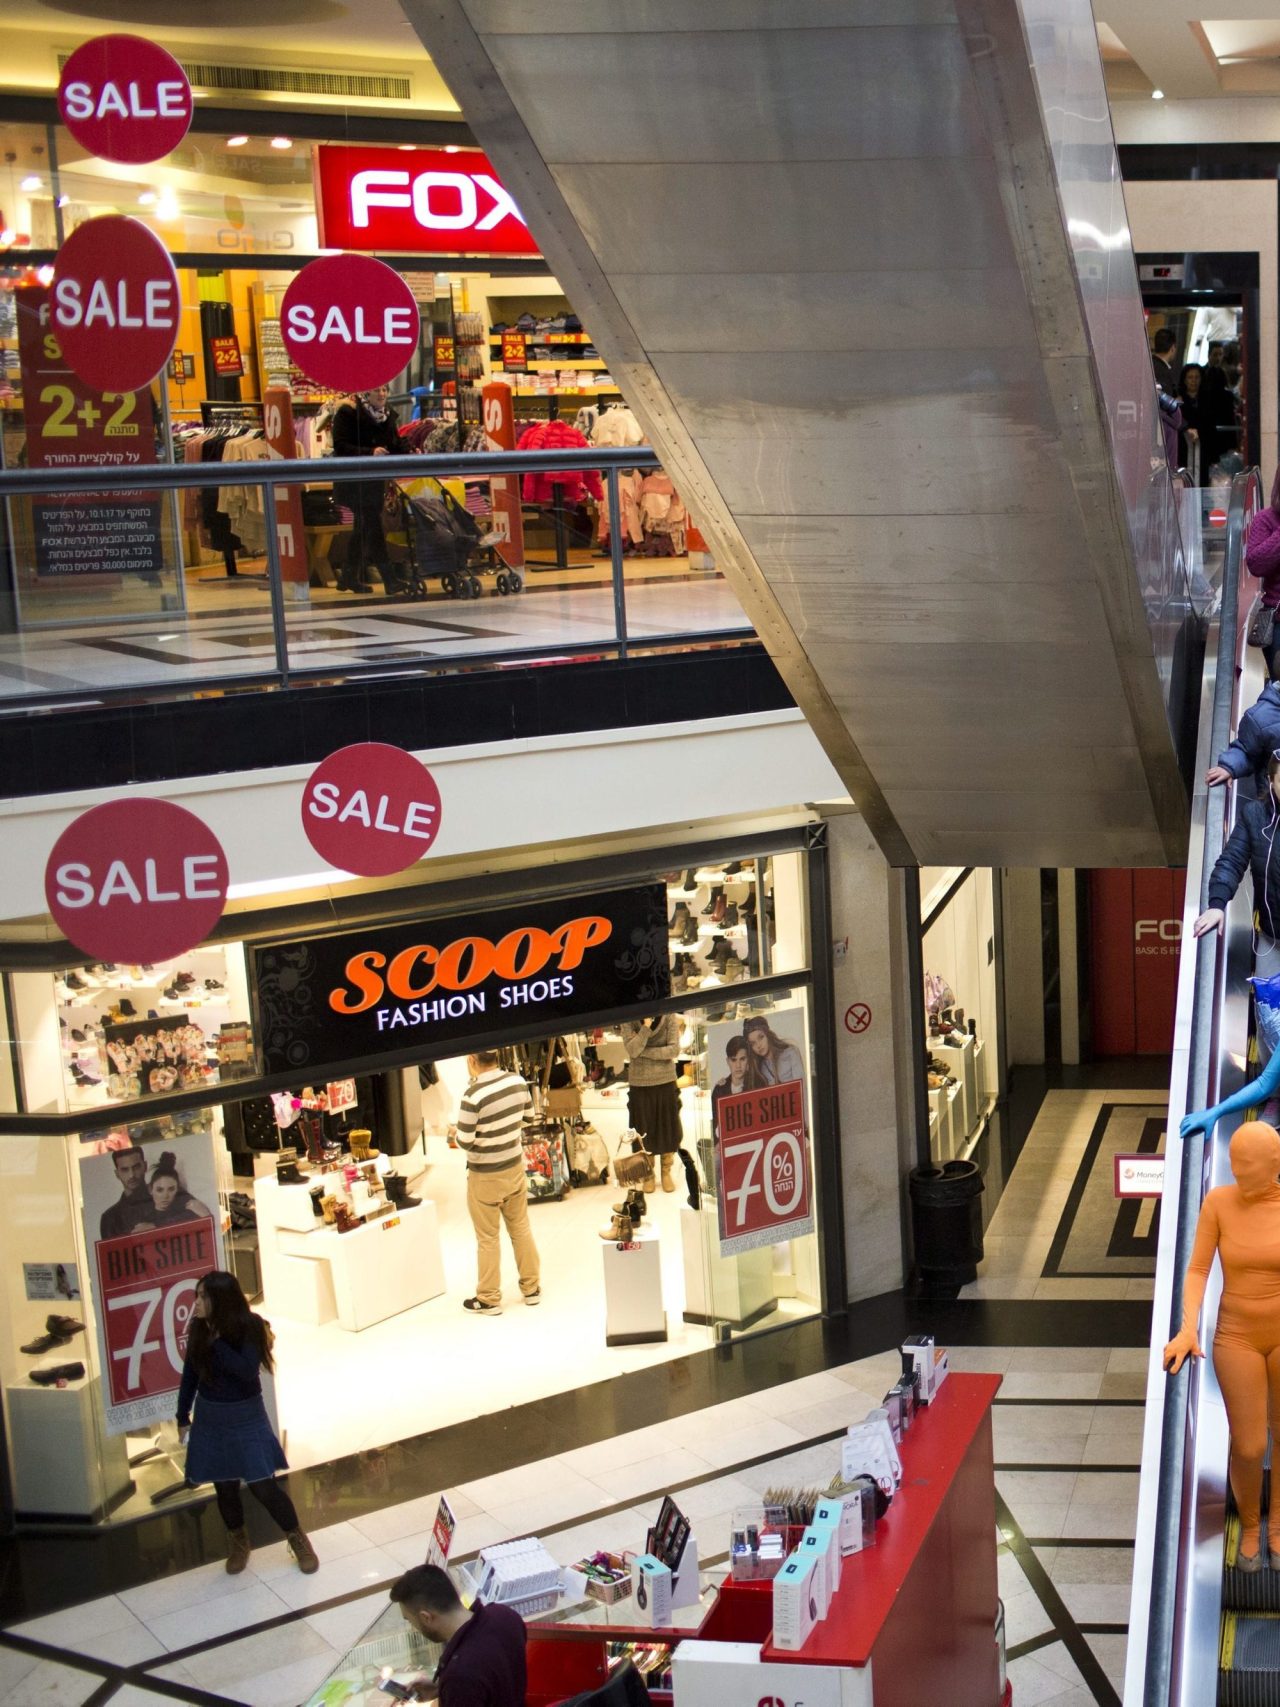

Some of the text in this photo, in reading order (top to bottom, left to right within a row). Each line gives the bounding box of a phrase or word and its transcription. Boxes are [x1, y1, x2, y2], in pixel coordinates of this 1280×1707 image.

[64, 81, 187, 119] SALE
[350, 170, 528, 231] FOX
[55, 279, 173, 328] SALE
[287, 304, 413, 345] SALE
[215, 349, 239, 364] 2+2
[504, 344, 526, 357] 2+2
[40, 385, 140, 437] 2+2
[44, 451, 140, 466] על קולקציית החורף
[41, 537, 63, 546] FOX
[308, 783, 436, 840] SALE
[55, 855, 221, 908] SALE
[1135, 919, 1184, 940] FO
[1135, 946, 1159, 955] BASIC
[329, 915, 613, 1014] SCOOP
[377, 975, 574, 1031] FASHION SHOES
[724, 1091, 798, 1132] BIG SALE
[724, 1131, 803, 1227] 70
[107, 1231, 208, 1281] BIG SALE
